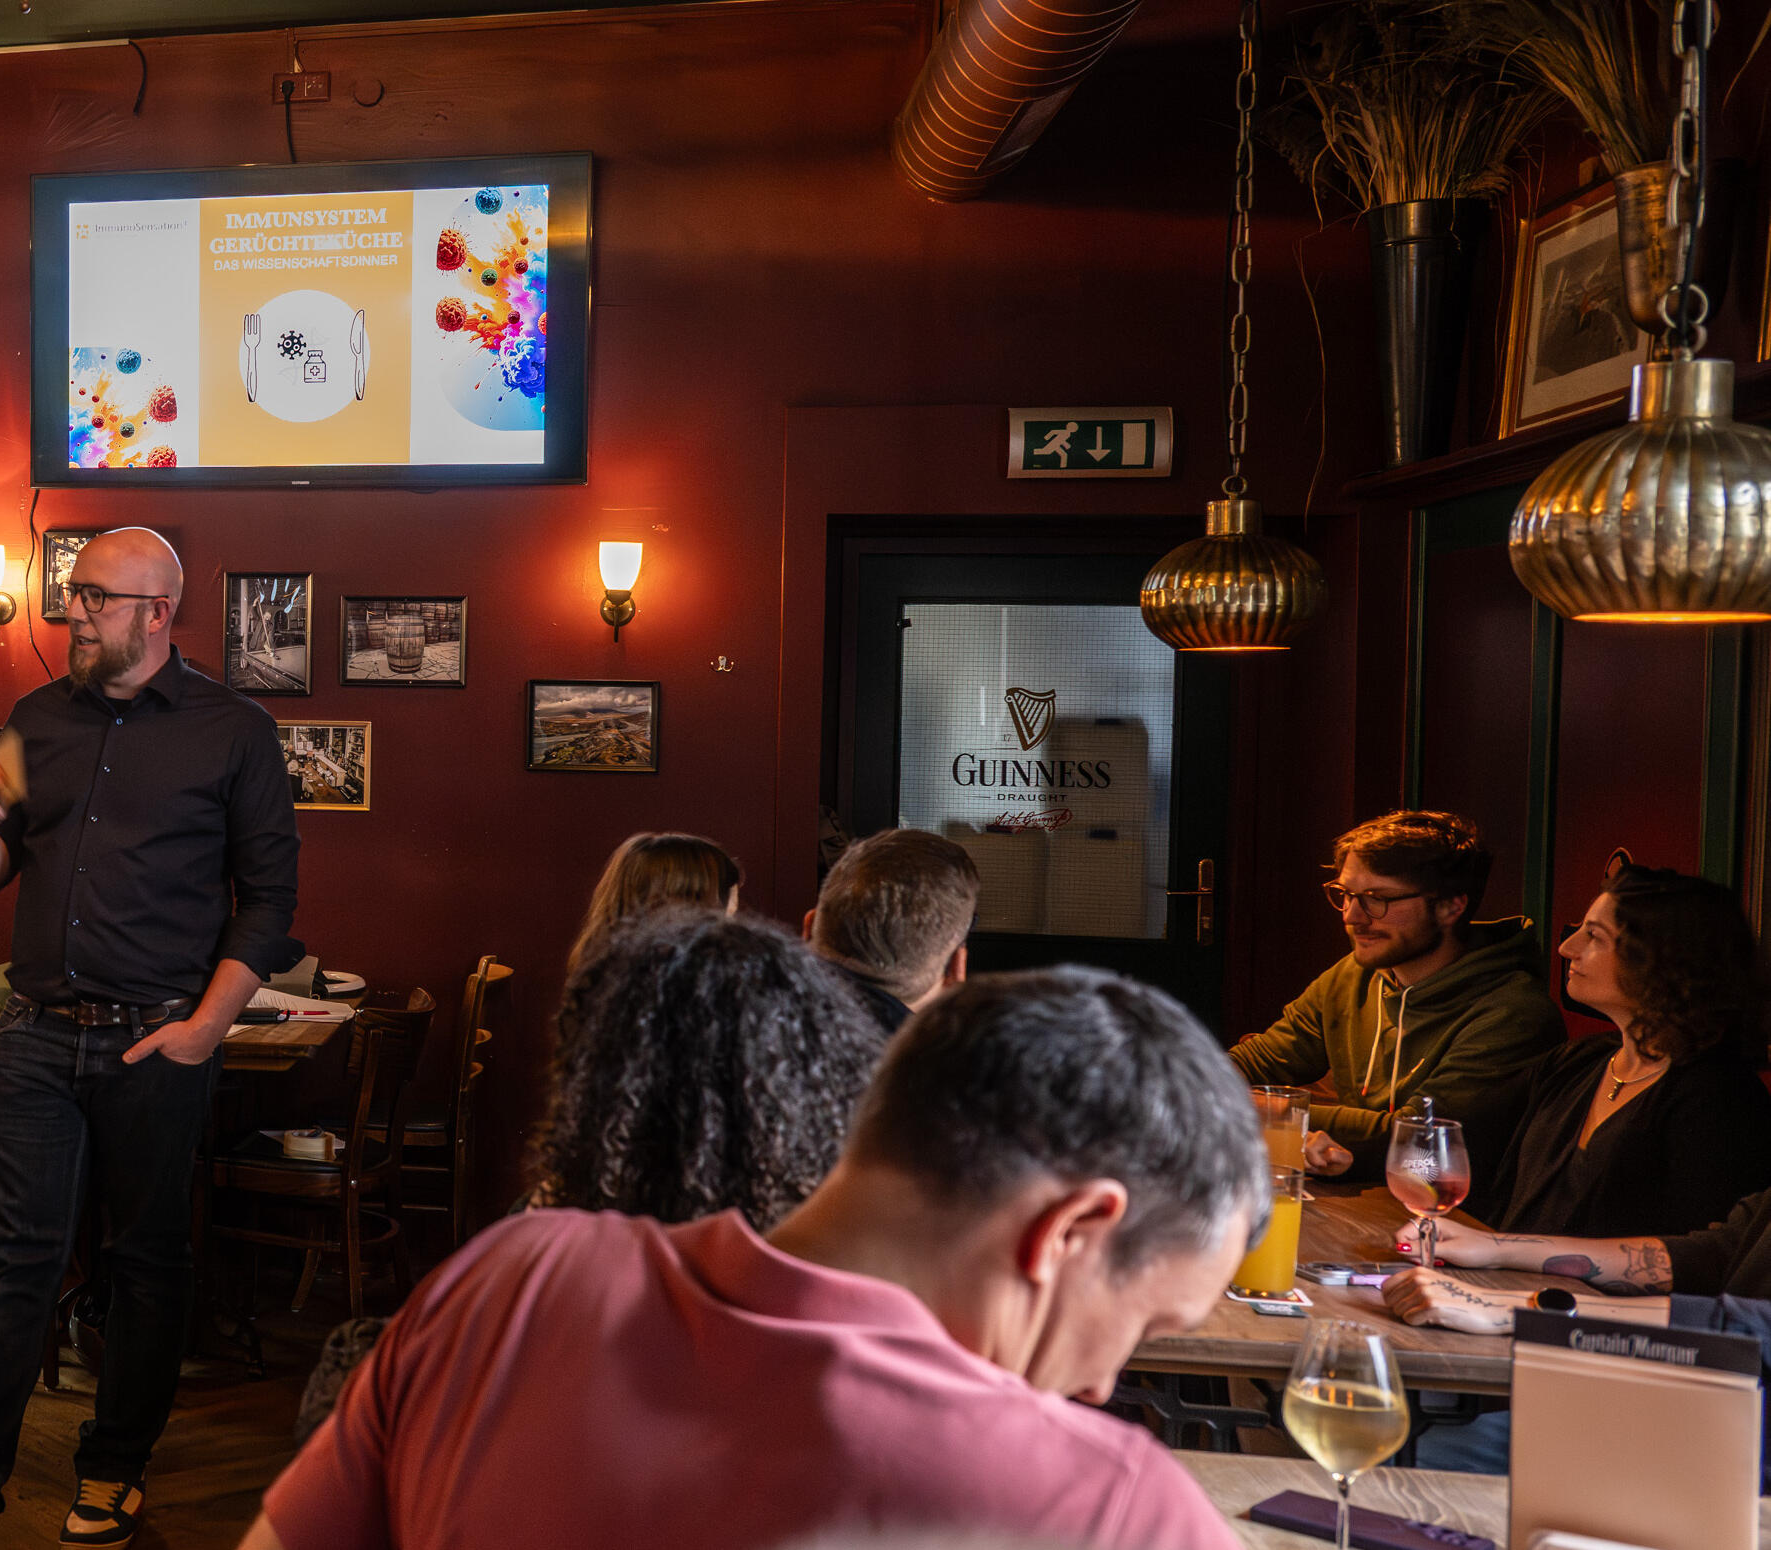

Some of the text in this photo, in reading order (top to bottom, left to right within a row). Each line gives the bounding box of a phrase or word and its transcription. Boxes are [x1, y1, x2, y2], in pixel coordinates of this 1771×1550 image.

[224, 207, 388, 230] IMMUNSYSTEM
[209, 231, 404, 255] GERÜCHTEKÜCHE
[213, 254, 399, 272] DAS WISSENSCHAFTSDINNER
[952, 753, 1111, 789] GUINNESS
[997, 793, 1068, 802] DRAUGHT
